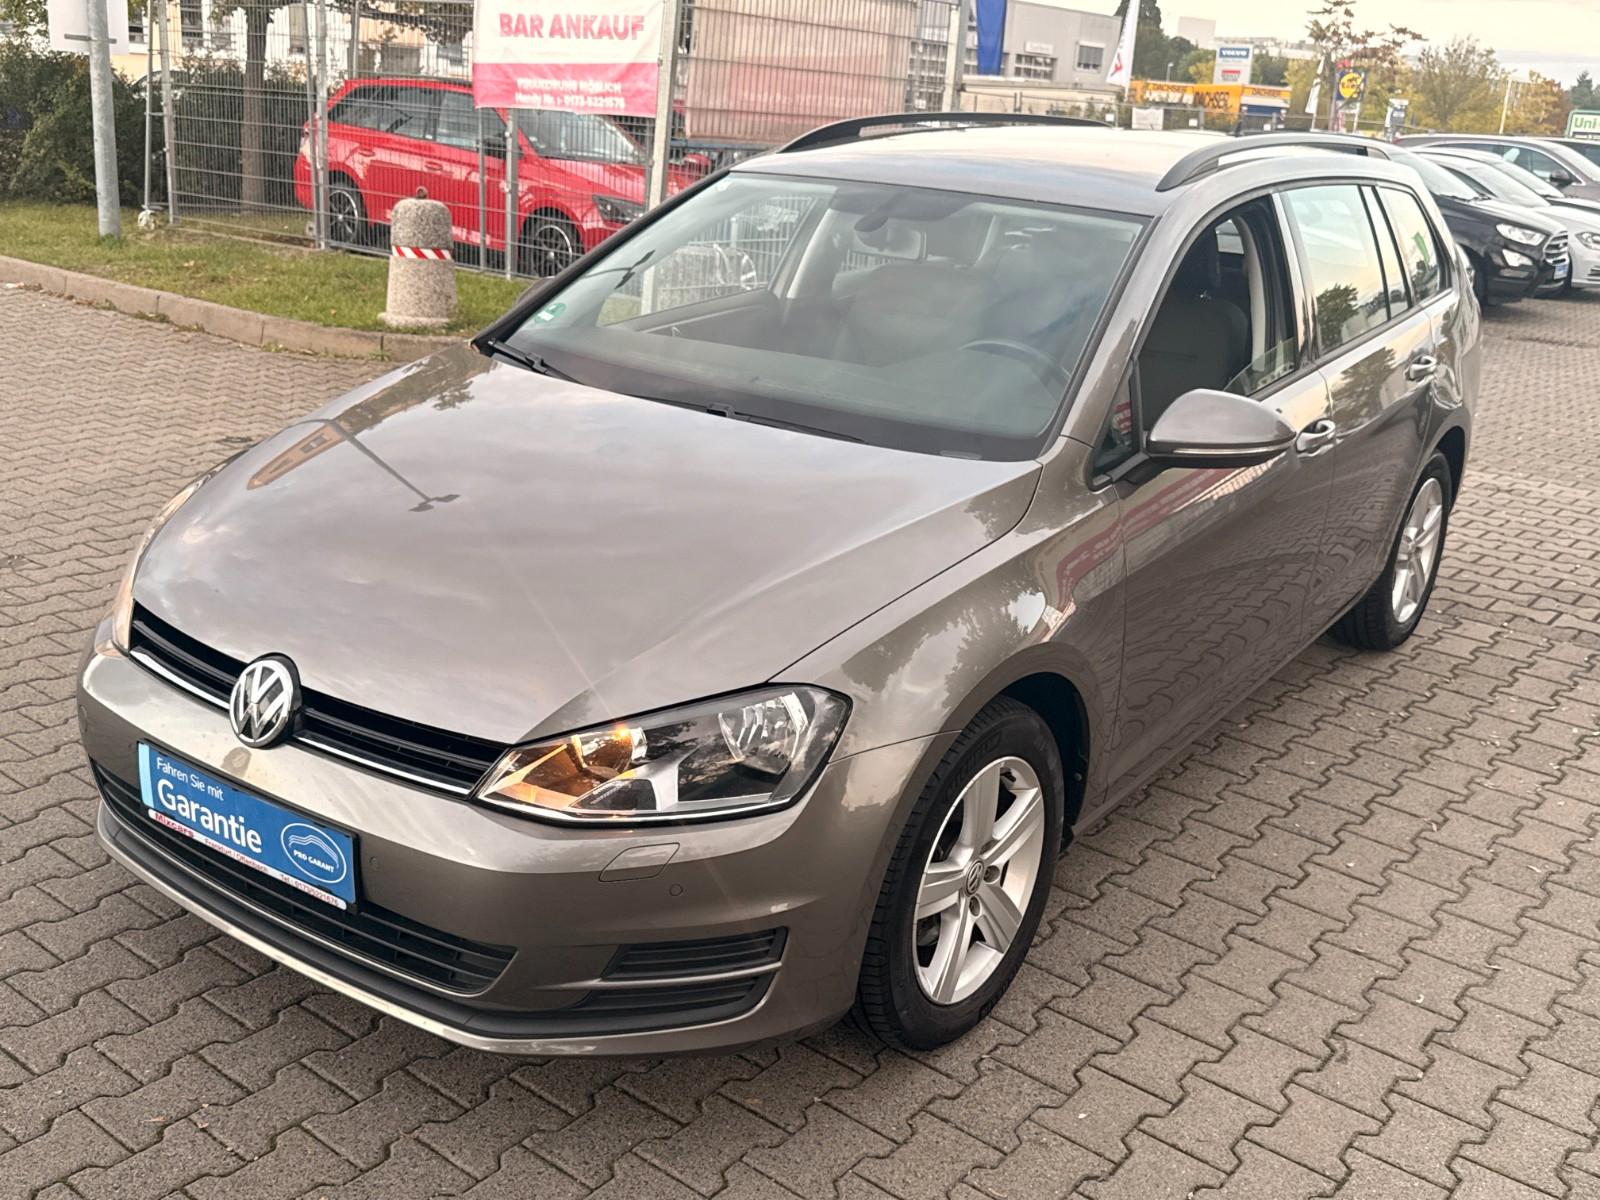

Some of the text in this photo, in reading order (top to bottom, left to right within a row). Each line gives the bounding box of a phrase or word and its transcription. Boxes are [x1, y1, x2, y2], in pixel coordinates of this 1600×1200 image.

[499, 13, 645, 40] BAR ANKAUF
[157, 757, 224, 801] Fahren Sie mit
[158, 779, 262, 853] Garantie
